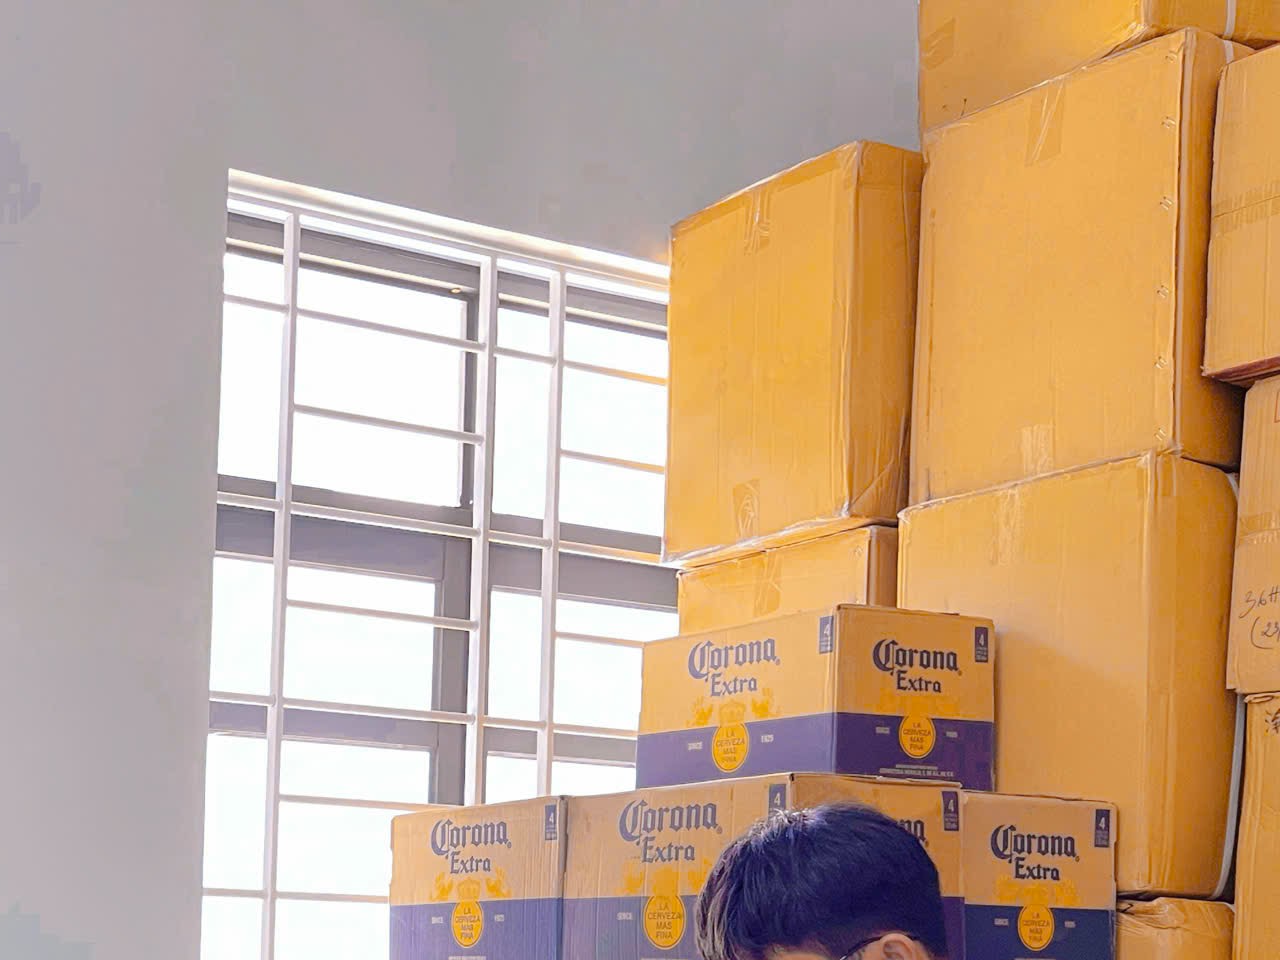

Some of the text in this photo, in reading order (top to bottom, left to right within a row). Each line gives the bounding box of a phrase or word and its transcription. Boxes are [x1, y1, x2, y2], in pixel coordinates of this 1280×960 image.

[687, 638, 778, 682] Corona
[872, 639, 959, 676] Corona
[710, 673, 757, 697] Extra
[896, 670, 941, 693] Extra
[774, 792, 781, 806] 4
[948, 799, 954, 812] 4
[549, 812, 554, 823] 4
[619, 799, 718, 846] Corona
[1099, 817, 1106, 830] 4
[431, 819, 509, 859] Corona
[640, 836, 695, 863] Extra
[990, 824, 1077, 863] Corona
[450, 851, 491, 874] Extra
[1014, 857, 1060, 881] Extra
